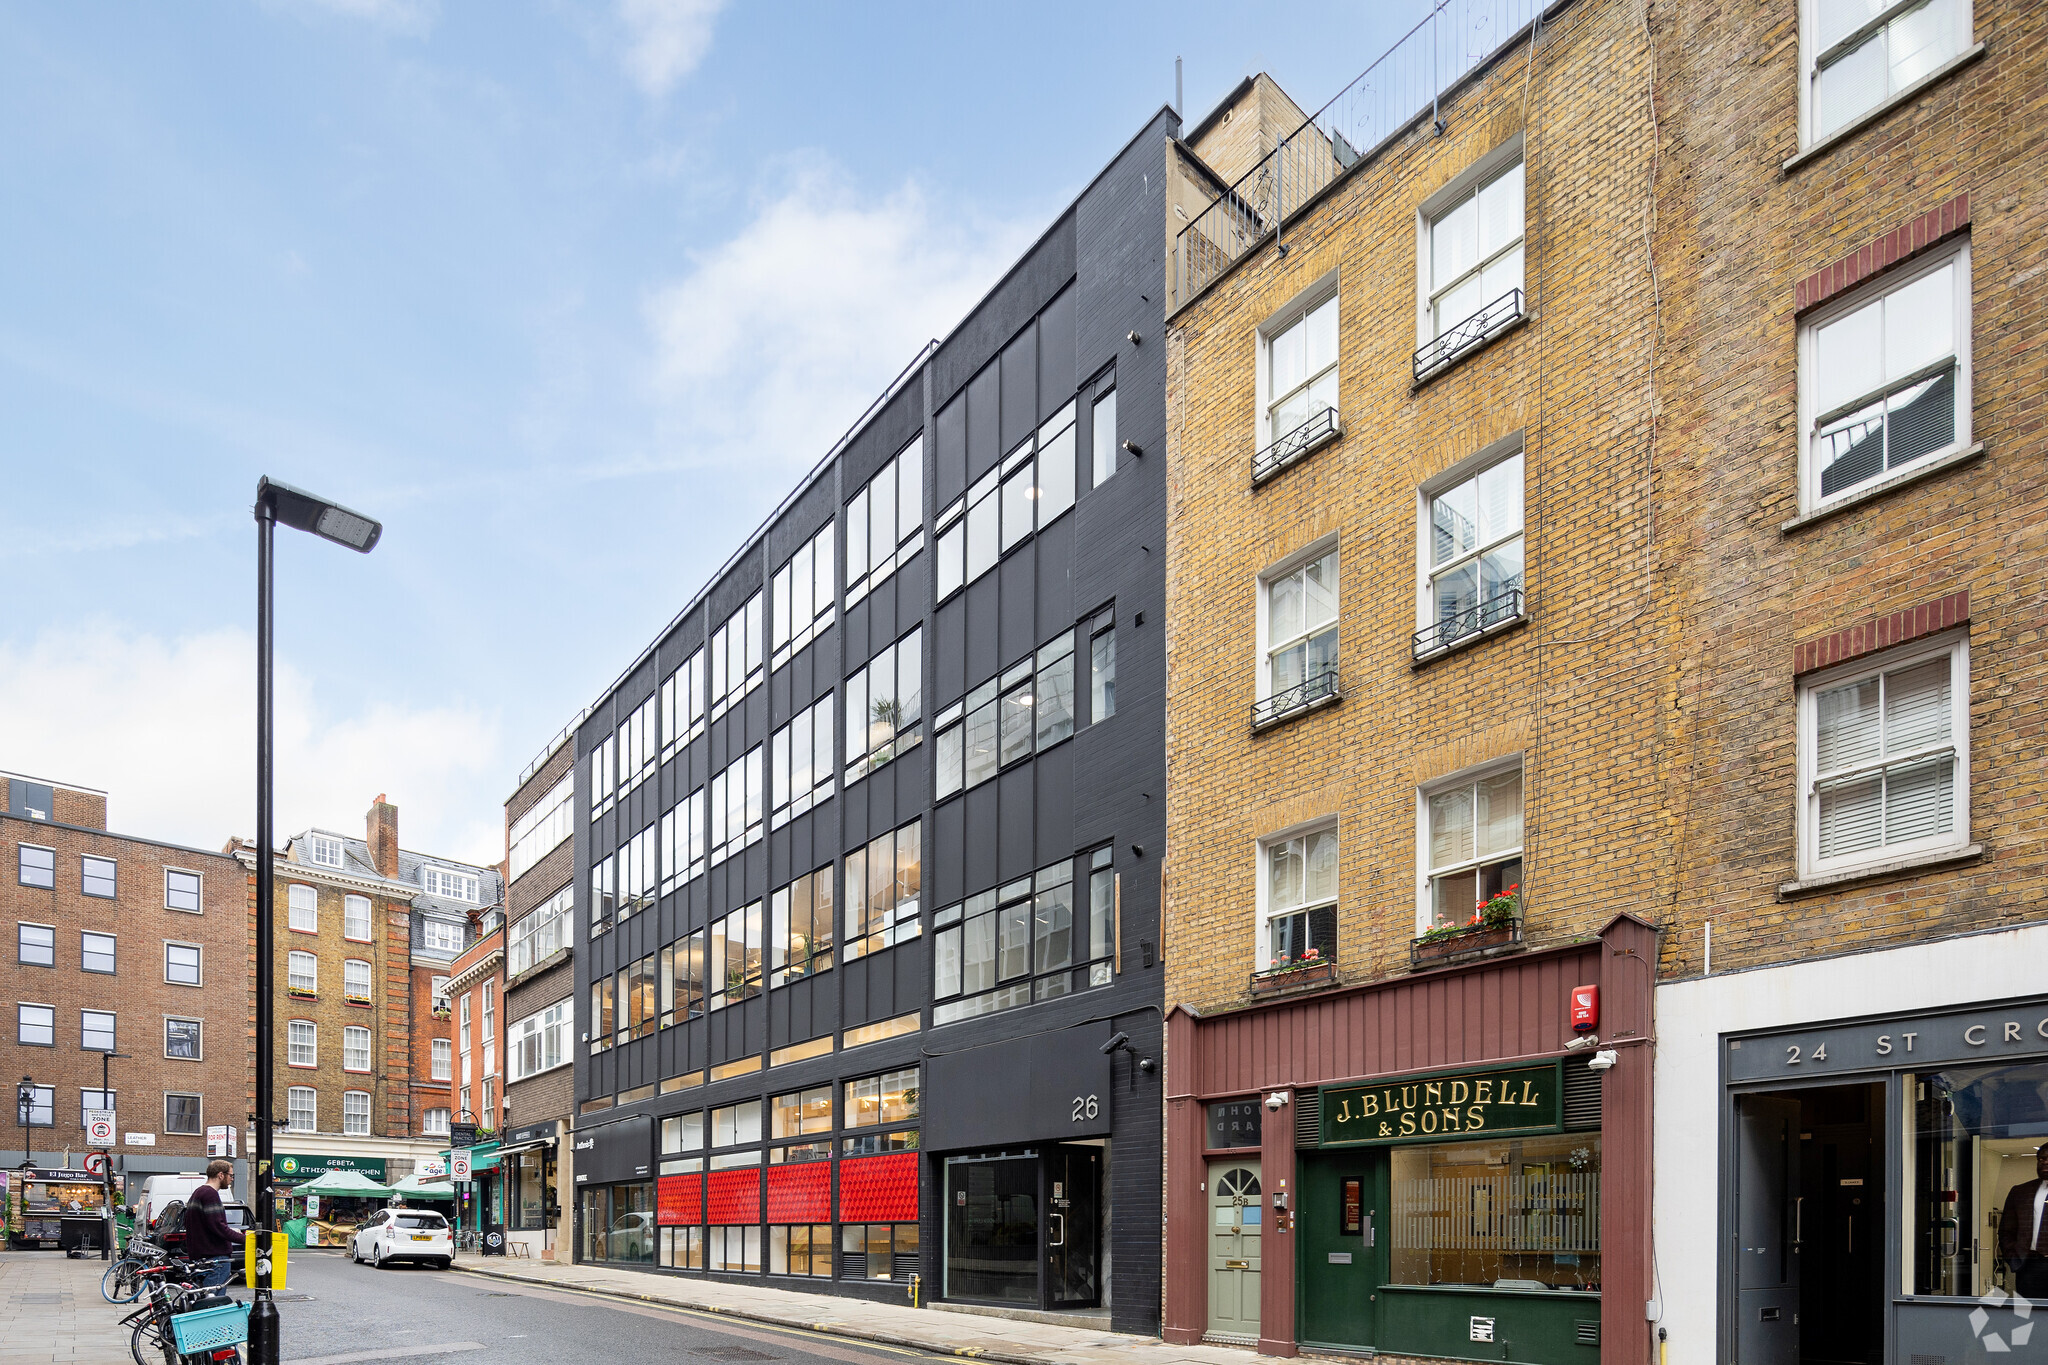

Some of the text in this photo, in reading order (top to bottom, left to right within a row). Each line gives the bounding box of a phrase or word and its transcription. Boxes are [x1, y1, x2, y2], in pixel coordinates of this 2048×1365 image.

[1786, 1042, 1827, 1064] 24
[1876, 1032, 1918, 1055] ST
[1072, 1094, 1098, 1121] 26
[1378, 1105, 1485, 1137] & SONS
